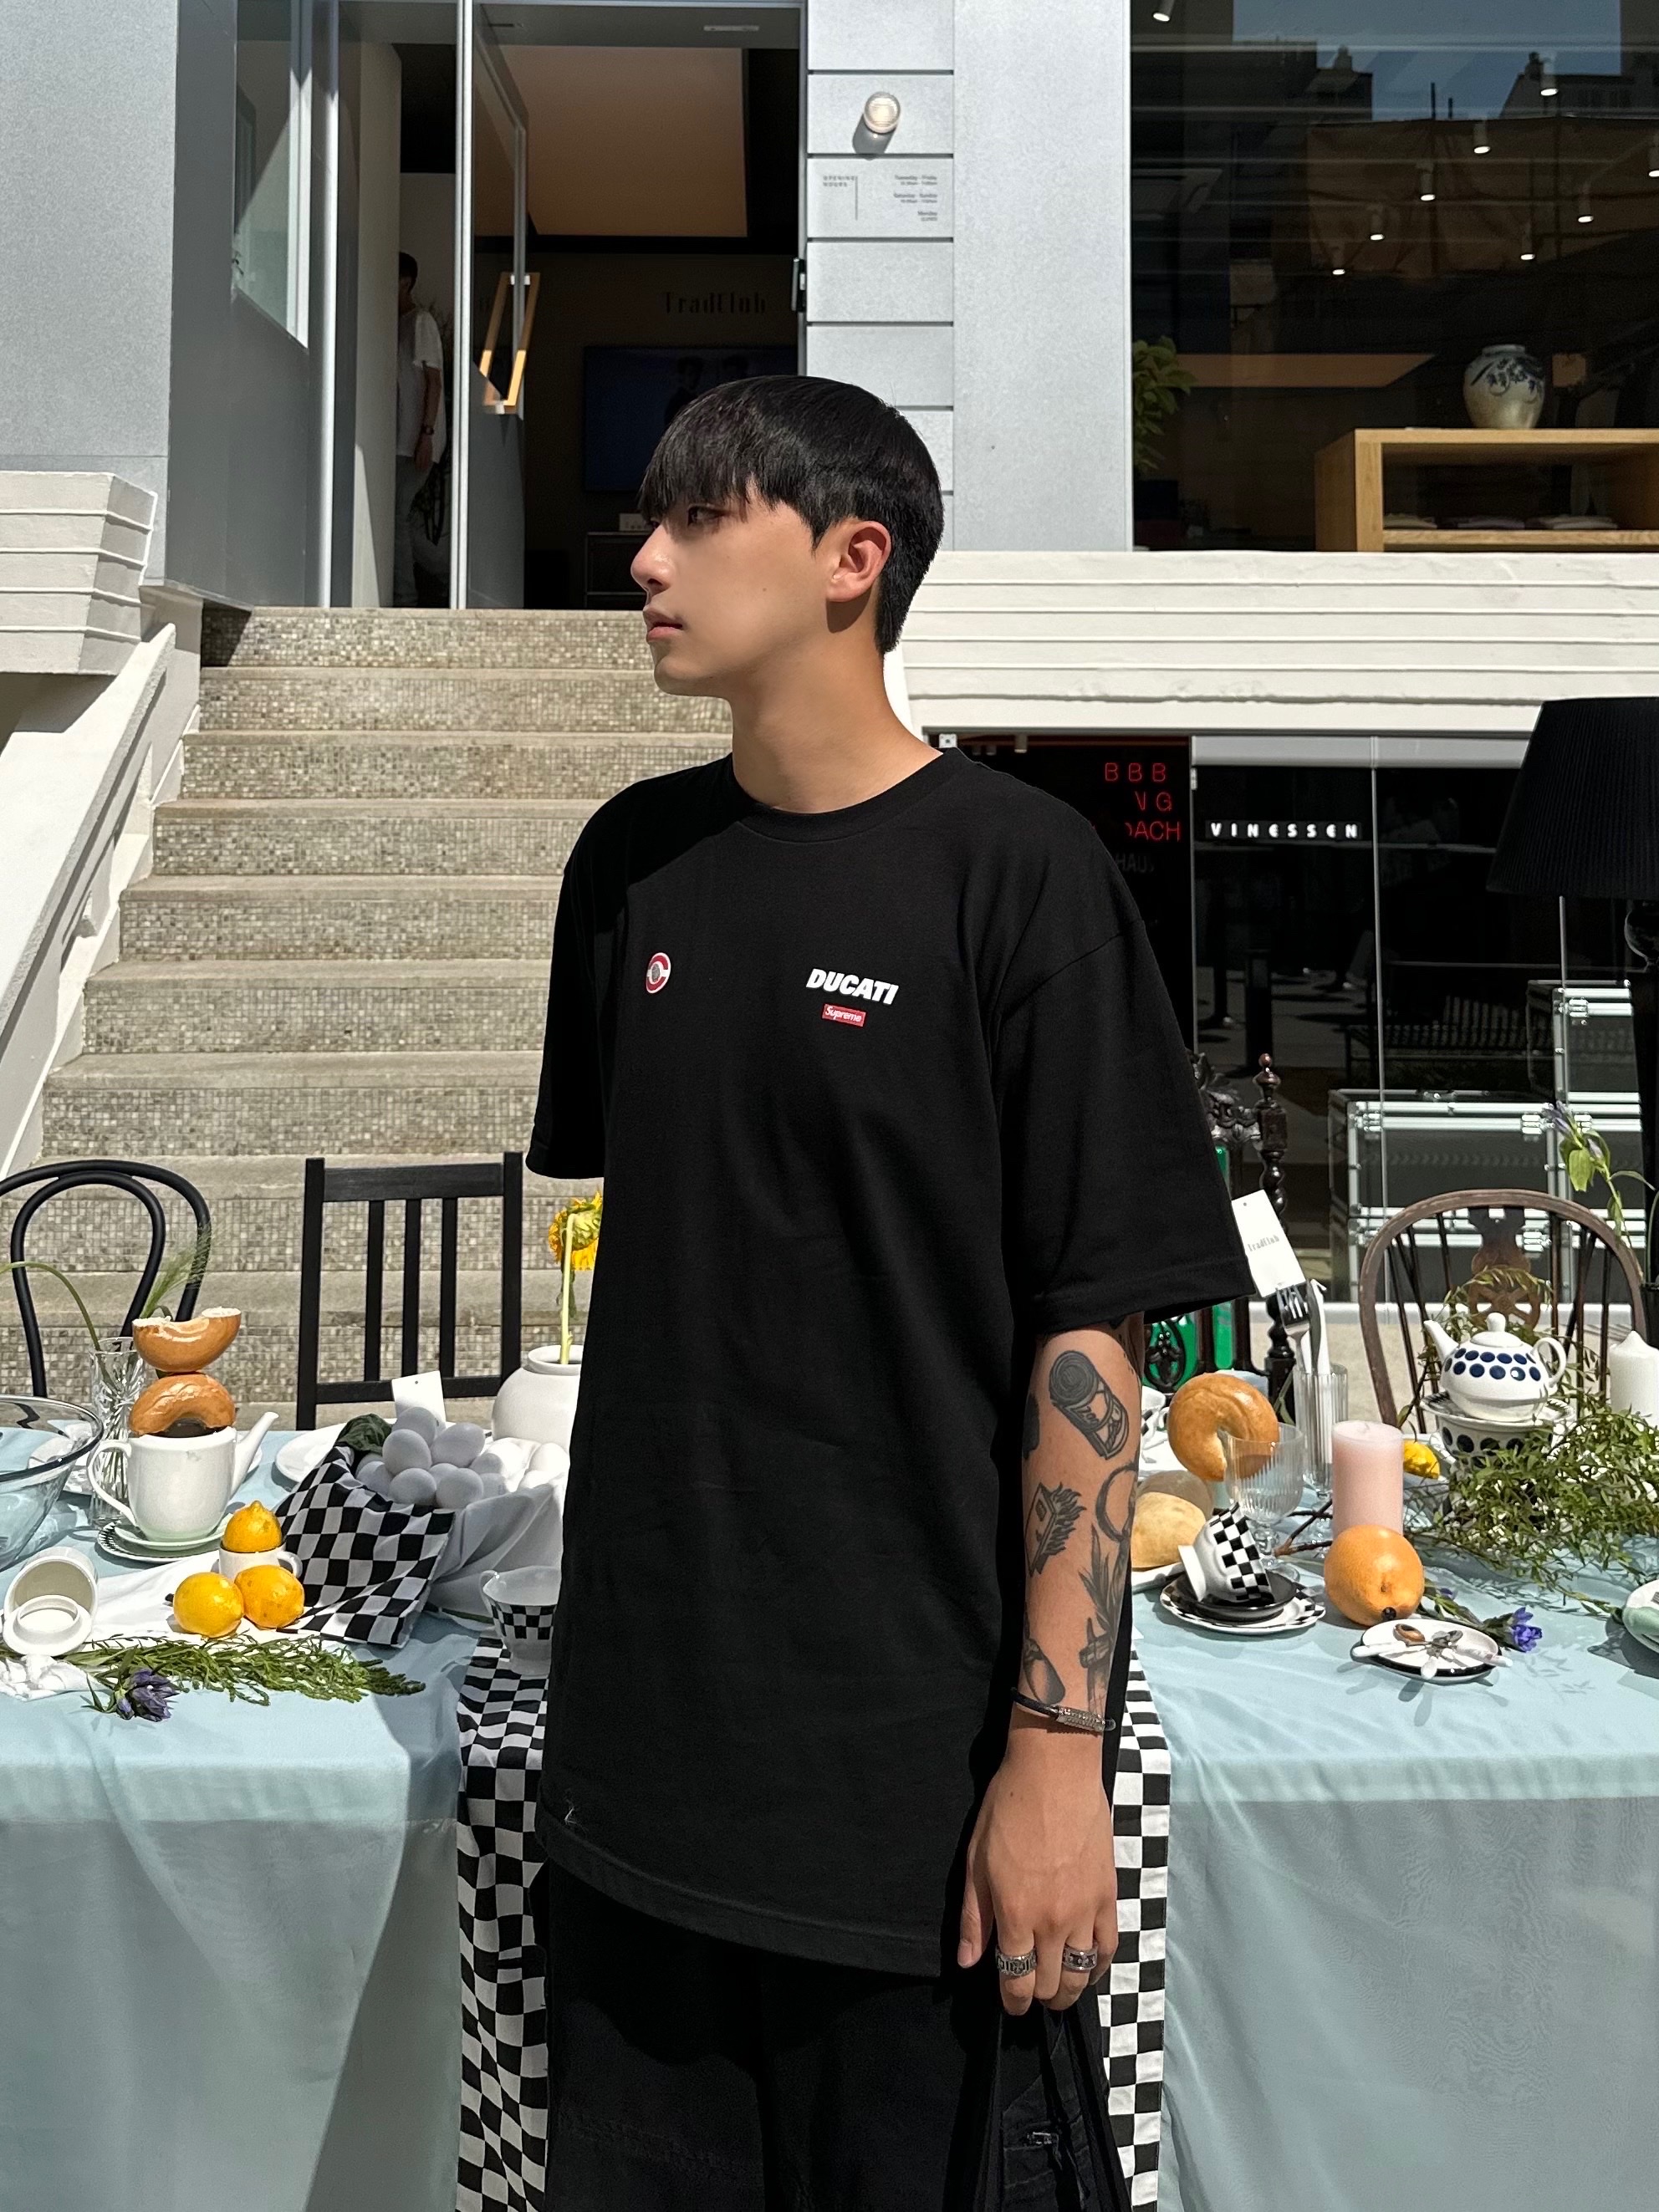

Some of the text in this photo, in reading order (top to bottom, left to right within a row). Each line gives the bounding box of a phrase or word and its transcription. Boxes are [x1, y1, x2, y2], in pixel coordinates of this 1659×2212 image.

[1210, 823, 1358, 839] VINESSEN
[805, 968, 900, 1005] DUCATI
[824, 1005, 863, 1022] Supreme
